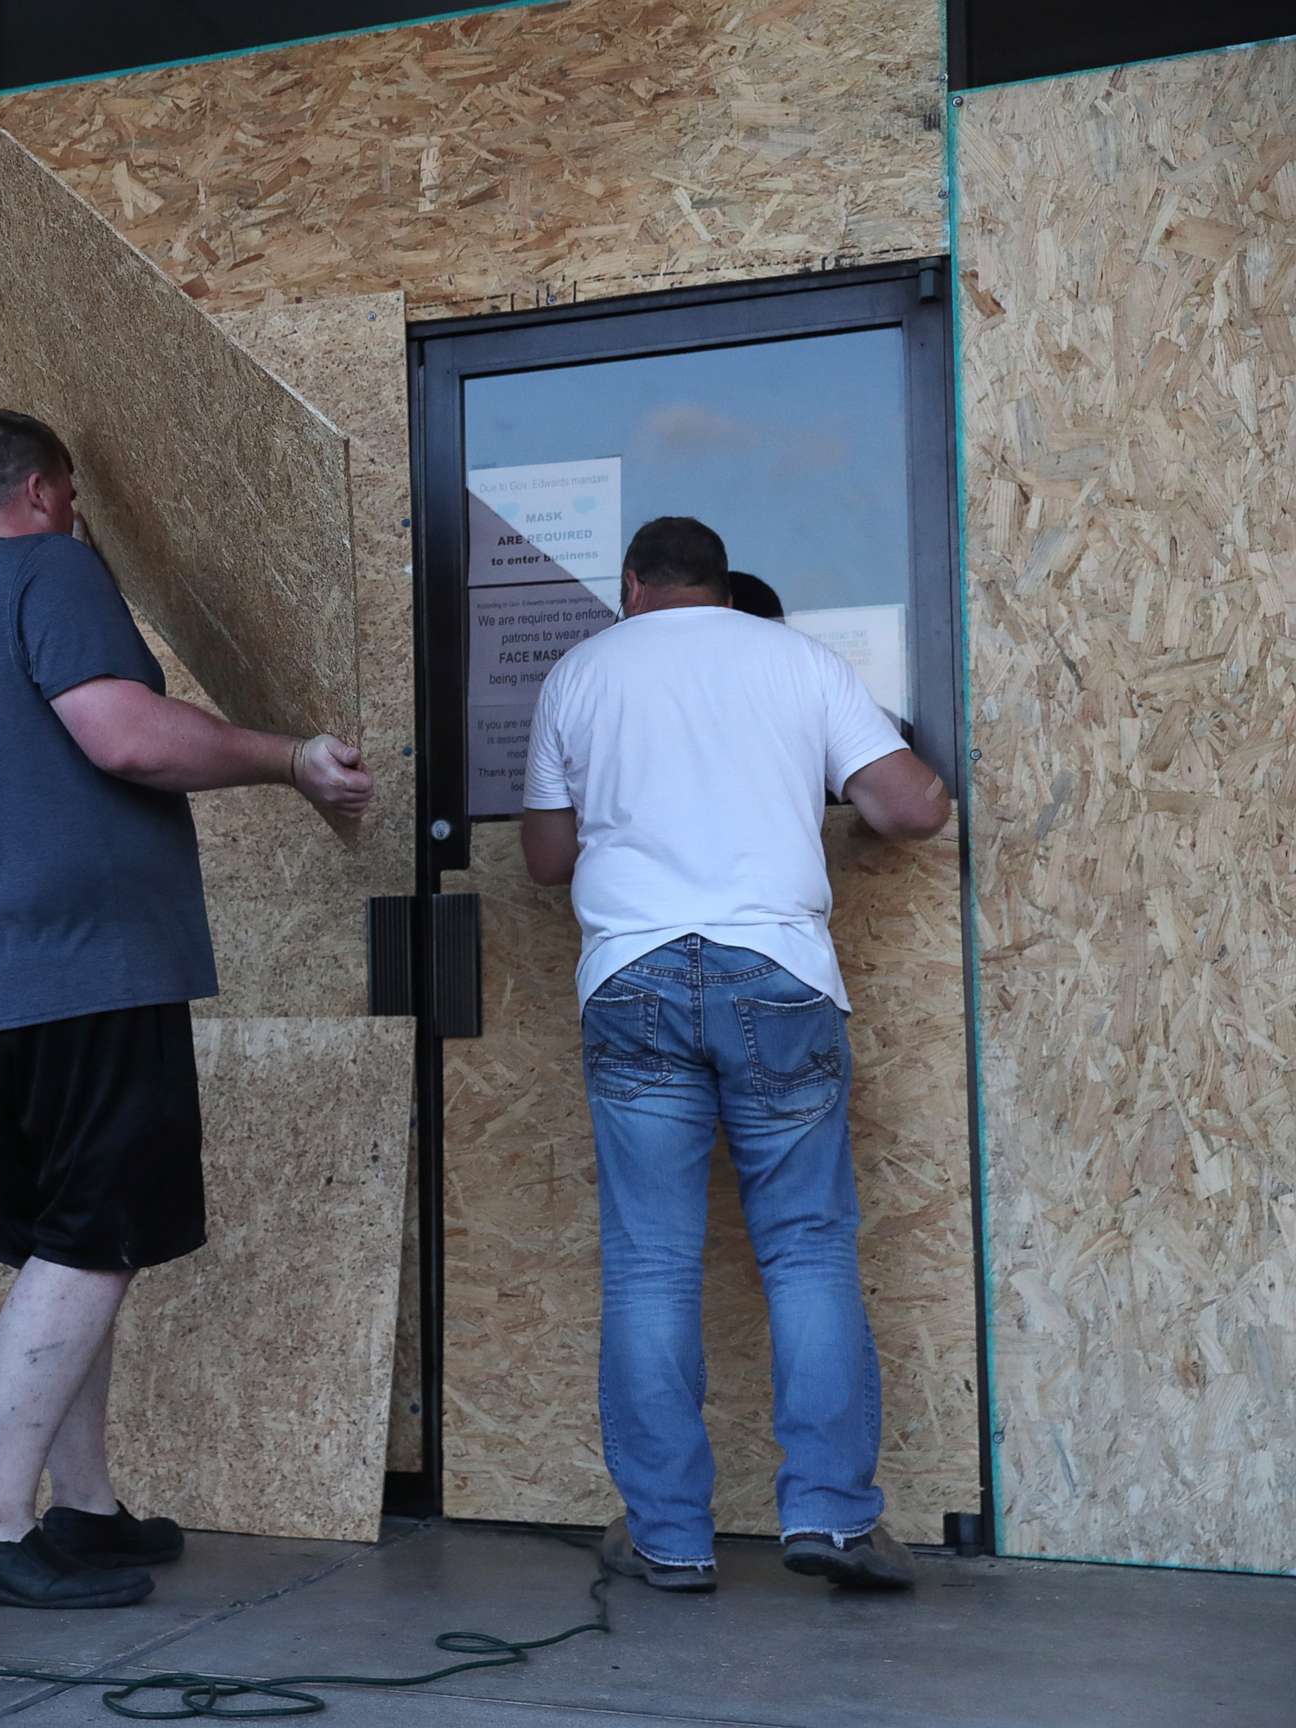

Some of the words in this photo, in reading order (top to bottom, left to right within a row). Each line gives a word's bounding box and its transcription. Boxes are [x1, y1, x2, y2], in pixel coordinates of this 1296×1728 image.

[479, 481, 495, 494] Due
[499, 481, 507, 491] to
[532, 475, 569, 489] Edwards
[570, 473, 609, 488] mandate
[525, 511, 563, 523] MASK
[497, 535, 524, 547] ARE
[527, 528, 593, 545] REQUIRED
[490, 557, 503, 567] to
[507, 553, 540, 566] enter
[543, 551, 599, 563] business
[478, 615, 496, 627] We
[498, 615, 515, 626] are
[517, 611, 560, 627] required
[562, 611, 572, 621] to
[575, 607, 613, 621] enforce
[501, 631, 540, 646] patrons
[542, 631, 553, 641] to
[554, 630, 580, 641] wear
[582, 629, 589, 638] a
[498, 651, 529, 664] FACE
[490, 673, 518, 685] being
[485, 721, 502, 732] you
[504, 720, 518, 728] are
[478, 767, 506, 777] Thank
[508, 768, 525, 779] you
